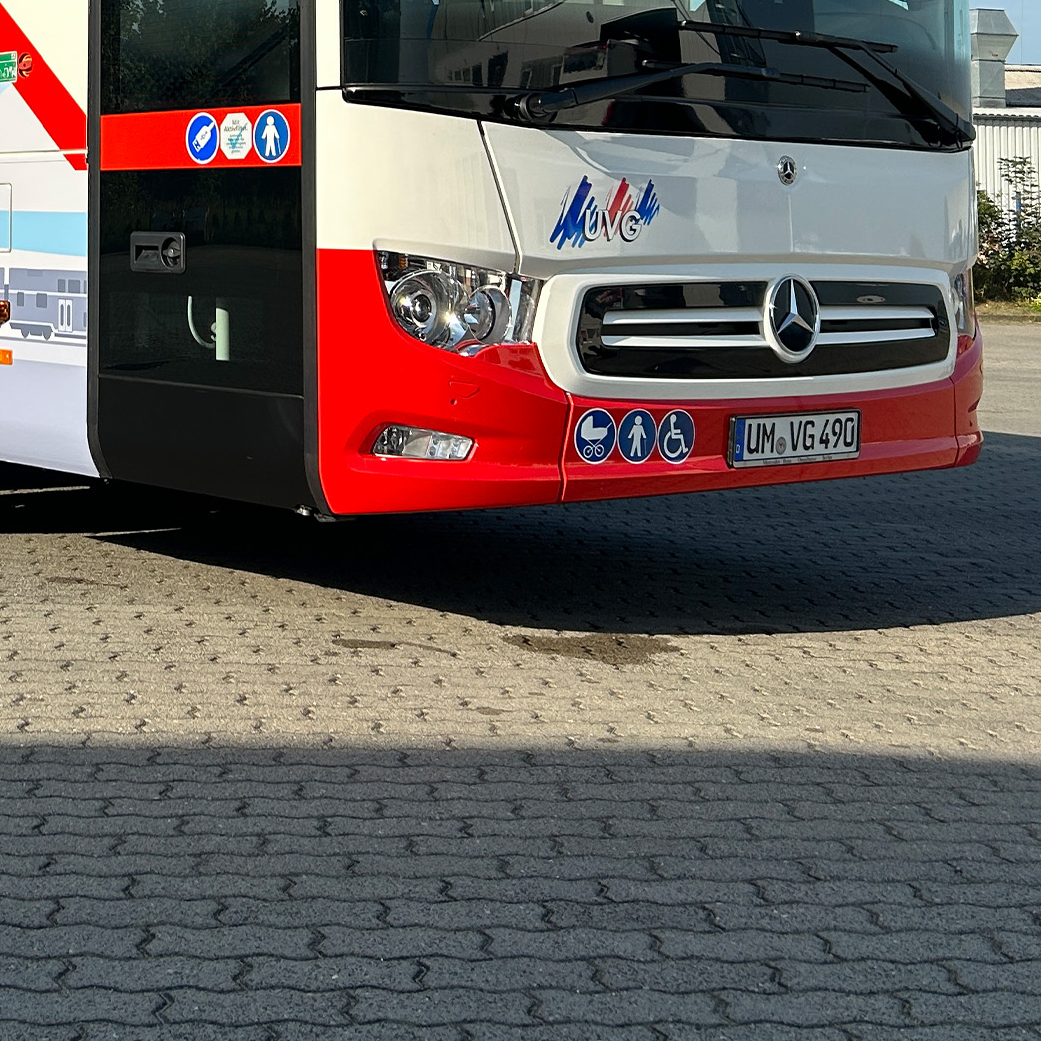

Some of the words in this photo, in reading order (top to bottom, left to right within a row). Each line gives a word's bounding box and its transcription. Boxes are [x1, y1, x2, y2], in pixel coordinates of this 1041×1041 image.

[583, 209, 642, 243] UVG
[746, 422, 776, 454] UM
[790, 420, 815, 452] VG
[819, 417, 855, 449] 490
